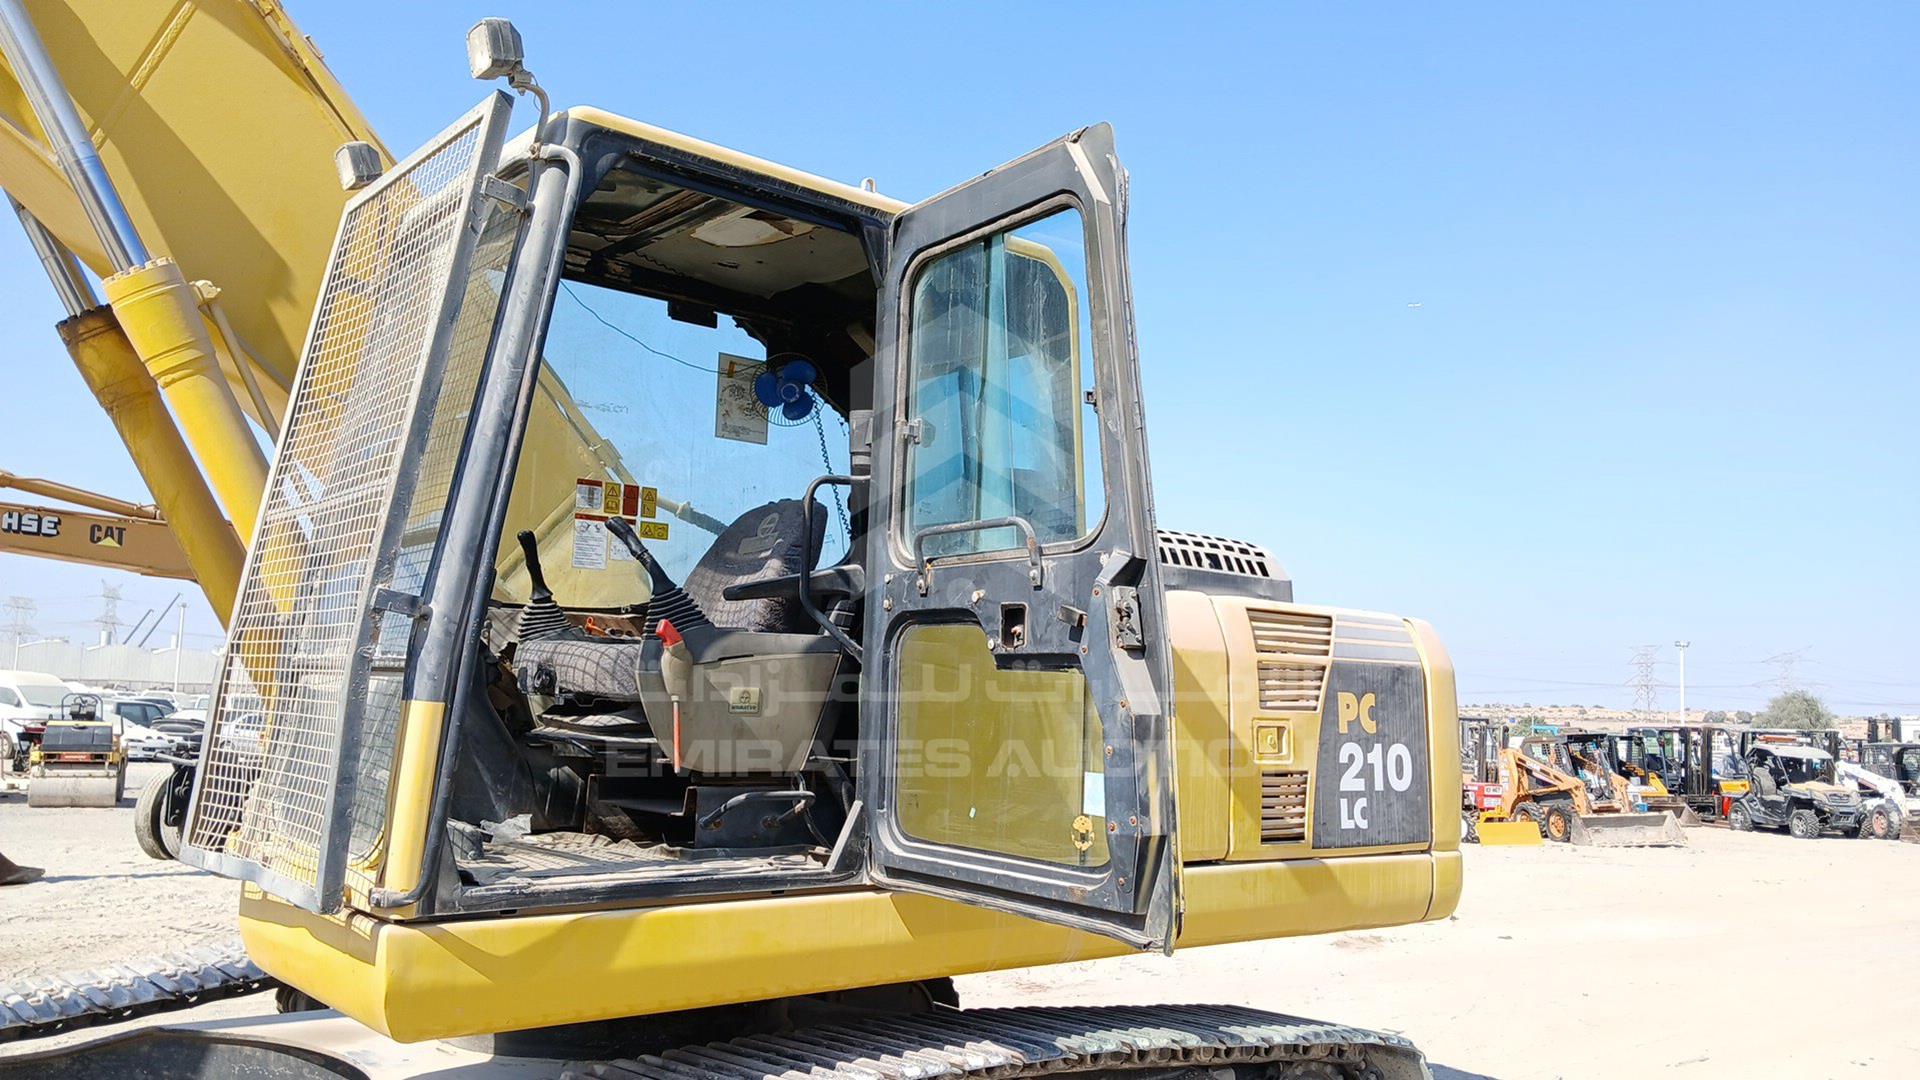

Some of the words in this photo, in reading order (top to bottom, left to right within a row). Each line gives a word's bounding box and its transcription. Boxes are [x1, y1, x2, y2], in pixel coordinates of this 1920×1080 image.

[1, 511, 60, 537] HSE
[89, 523, 126, 547] CAT
[1337, 691, 1377, 734] PC
[1339, 741, 1413, 792] 210
[1340, 797, 1369, 830] LC
